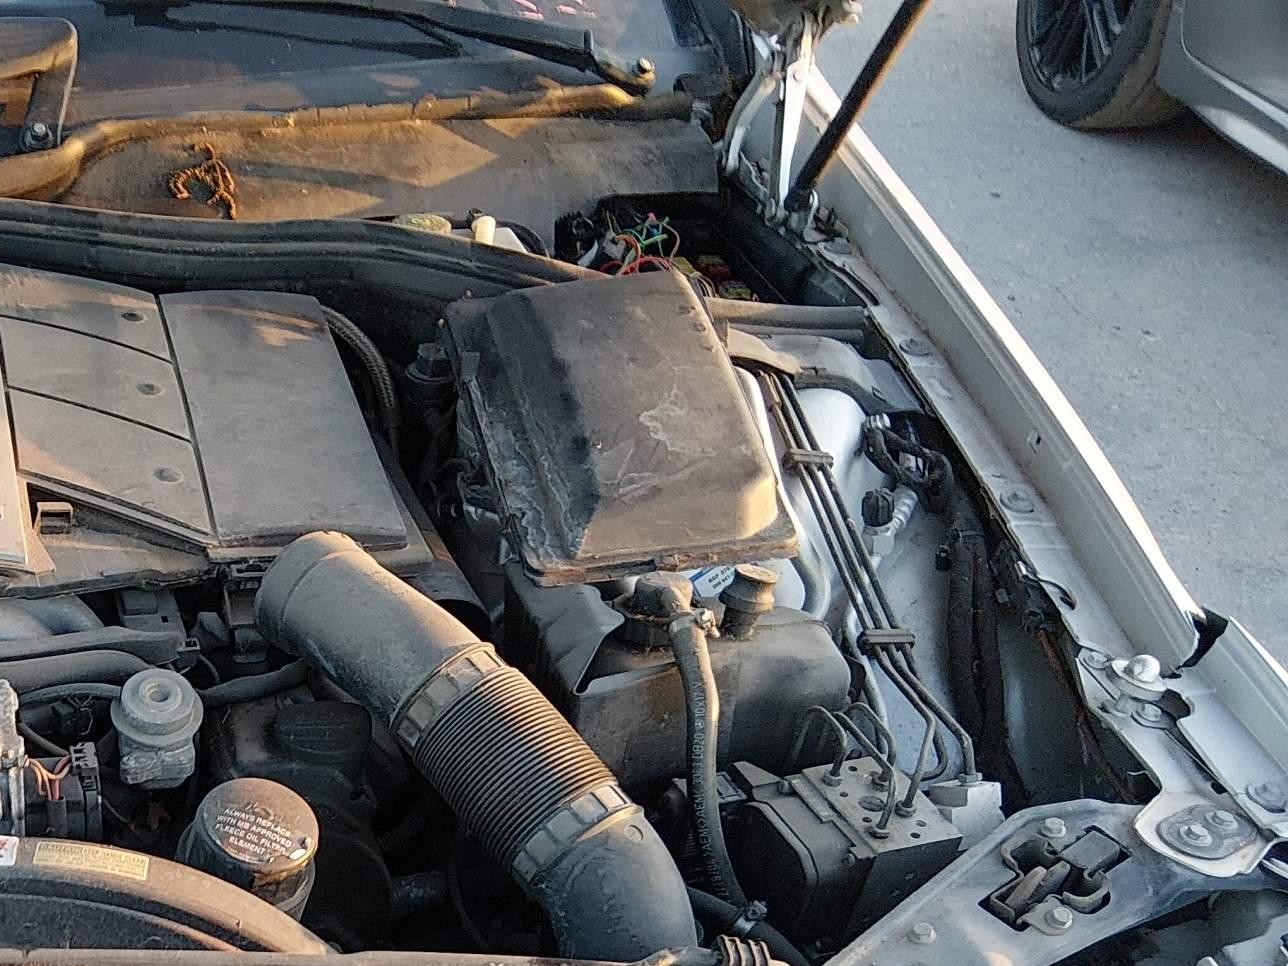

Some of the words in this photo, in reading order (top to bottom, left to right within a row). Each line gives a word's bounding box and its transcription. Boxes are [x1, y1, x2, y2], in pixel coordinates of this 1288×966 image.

[215, 823, 245, 838] FLEECE
[246, 833, 259, 843] OIL
[217, 815, 237, 826] WITH
[237, 821, 250, 830] MB
[250, 825, 292, 848] APPROVED
[224, 808, 256, 821] ALWAYS
[256, 817, 291, 837] REPLACE
[228, 836, 266, 855] ELEMENT
